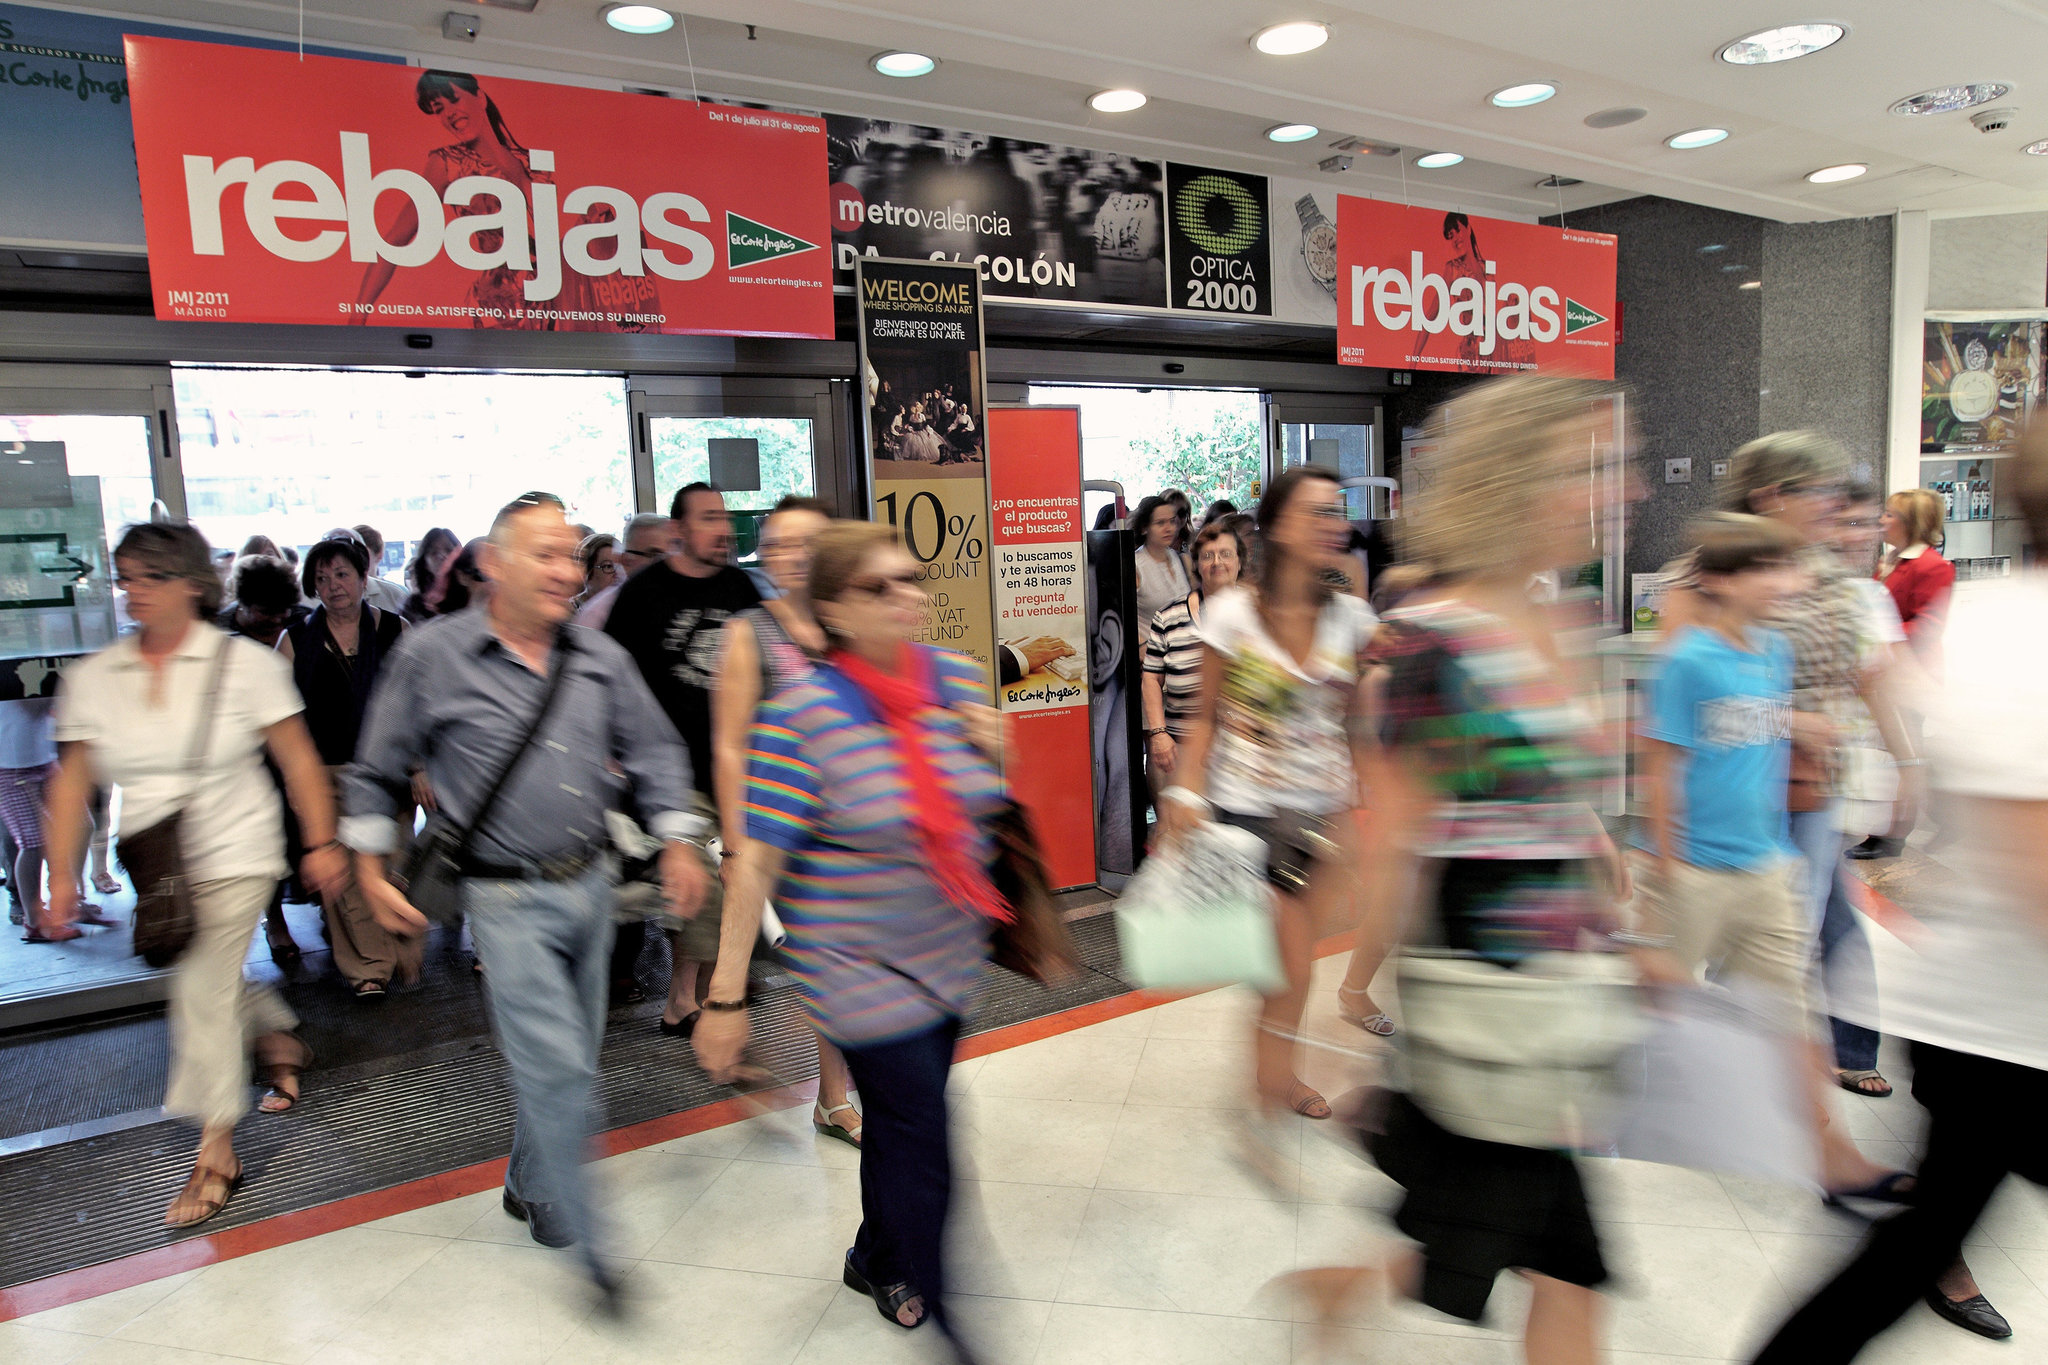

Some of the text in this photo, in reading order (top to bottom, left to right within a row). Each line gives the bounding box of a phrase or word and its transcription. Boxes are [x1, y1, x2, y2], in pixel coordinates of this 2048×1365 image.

[88, 53, 125, 65] SERVI
[9, 62, 74, 91] Corte
[708, 111, 820, 134] Del 1 de julio al 31 de agosto
[183, 131, 715, 301] rebajas
[838, 199, 1012, 237] metrovalencia
[730, 233, 796, 252] El Corte Inglés
[1190, 255, 1256, 282] OPTICA
[728, 276, 823, 288] www.elcorteingles.es
[863, 278, 970, 305] WELCOME
[1186, 280, 1257, 312] 2000
[864, 300, 974, 314] WHERE SHOPPING IS AN ART
[1352, 250, 1560, 356] rebajas
[174, 307, 227, 318] MADRID
[338, 302, 666, 324] SI NO QUEDA SATISFECHO, LE DEVOLVEMOS SU DINERO
[875, 318, 962, 332] BIENVENIDO DONDE
[872, 328, 966, 340] COMPRAR ES UN ARTE
[992, 496, 1079, 511] ¿no encuentras
[1004, 509, 1068, 523] el producto
[876, 491, 984, 563] 10%
[1002, 522, 1072, 537] que buscas?
[1003, 551, 1073, 562] lo buscamos
[914, 560, 982, 582] COUNT
[1000, 564, 1076, 578] y te avisamos
[1006, 576, 1072, 588] en 48 horas
[1015, 592, 1064, 606] pregunta
[936, 608, 966, 624] VAT
[1002, 604, 1079, 618] a tu vendedor
[1008, 690, 1019, 702] El
[1019, 689, 1044, 702] Corte
[1045, 684, 1080, 704] Inglés
